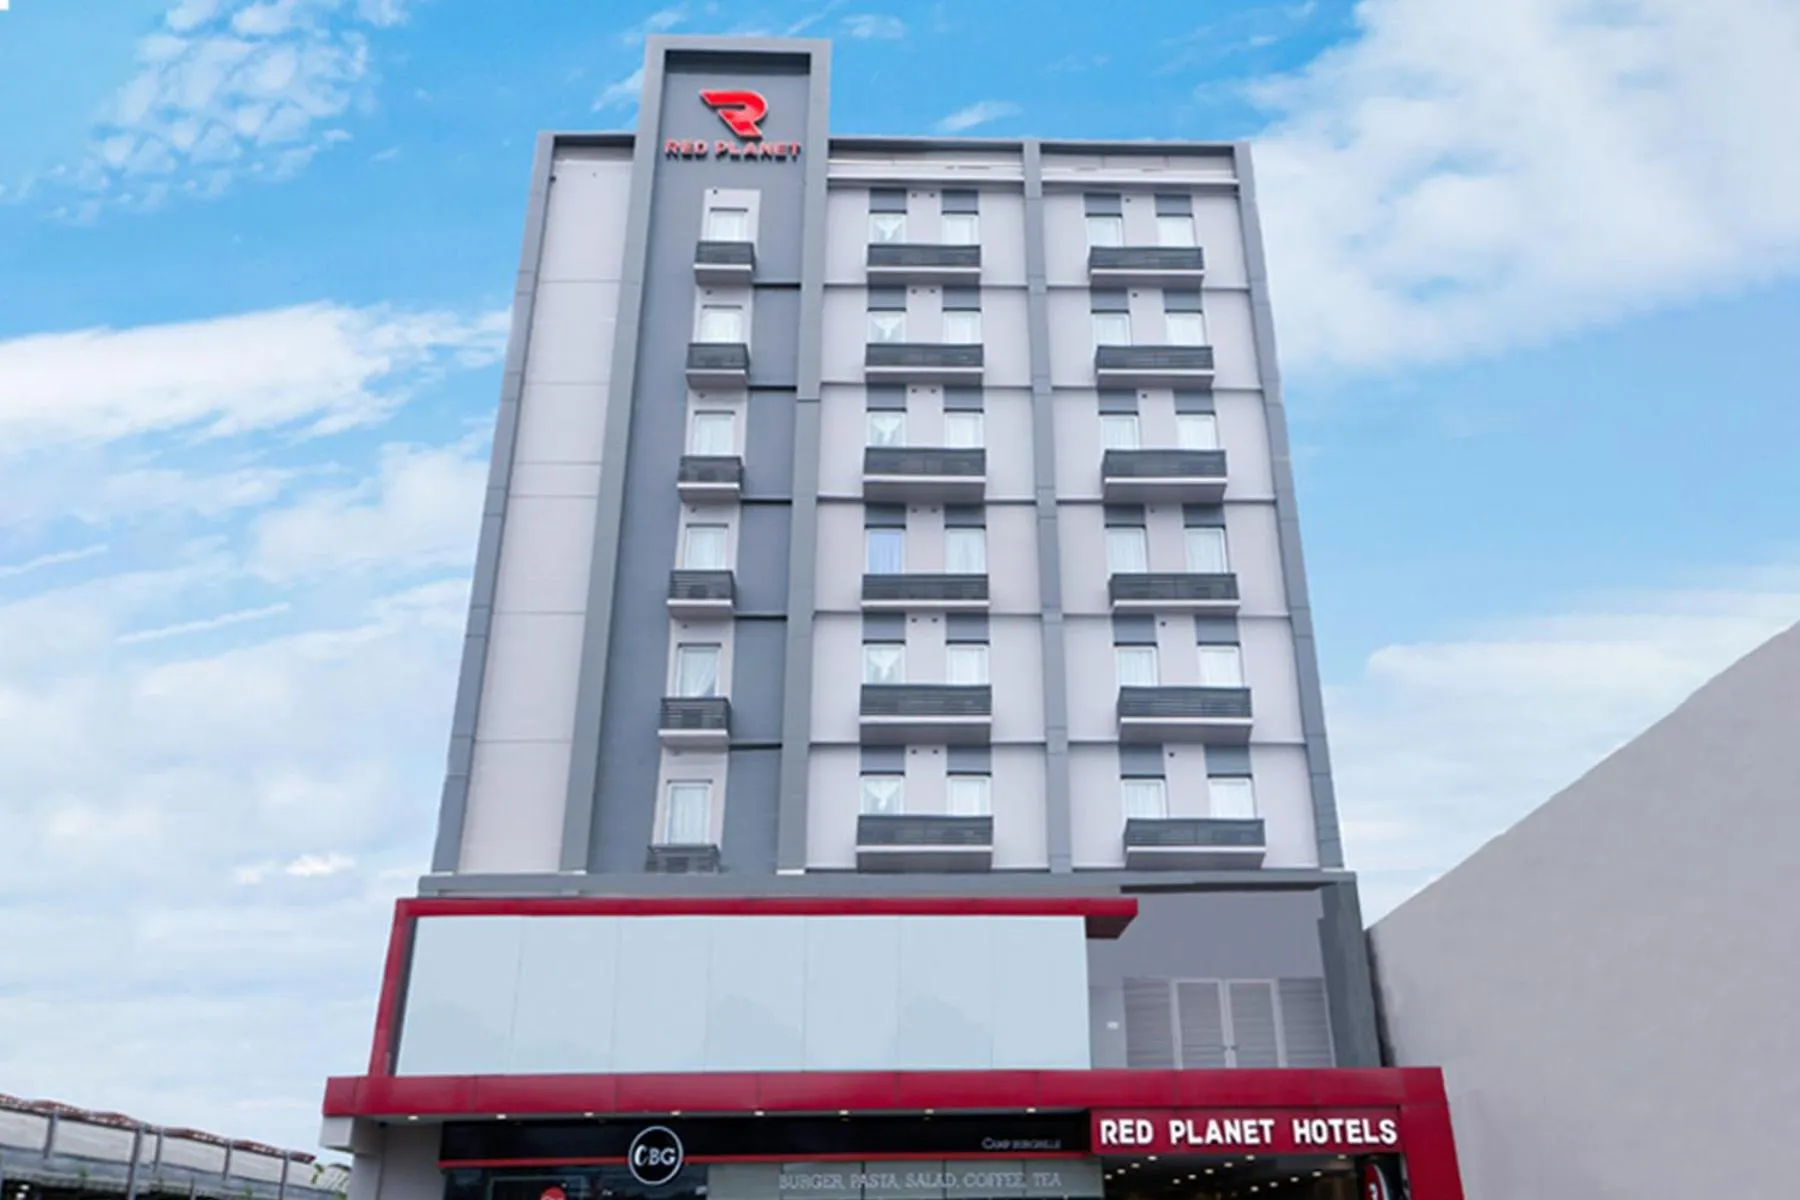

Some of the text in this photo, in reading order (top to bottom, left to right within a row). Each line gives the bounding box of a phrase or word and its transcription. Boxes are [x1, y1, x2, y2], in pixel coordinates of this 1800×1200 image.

[664, 138, 801, 161] RED PLANET
[1100, 1118, 1399, 1145] RED PLANET HOTELS
[1032, 1172, 1062, 1187] TEA
